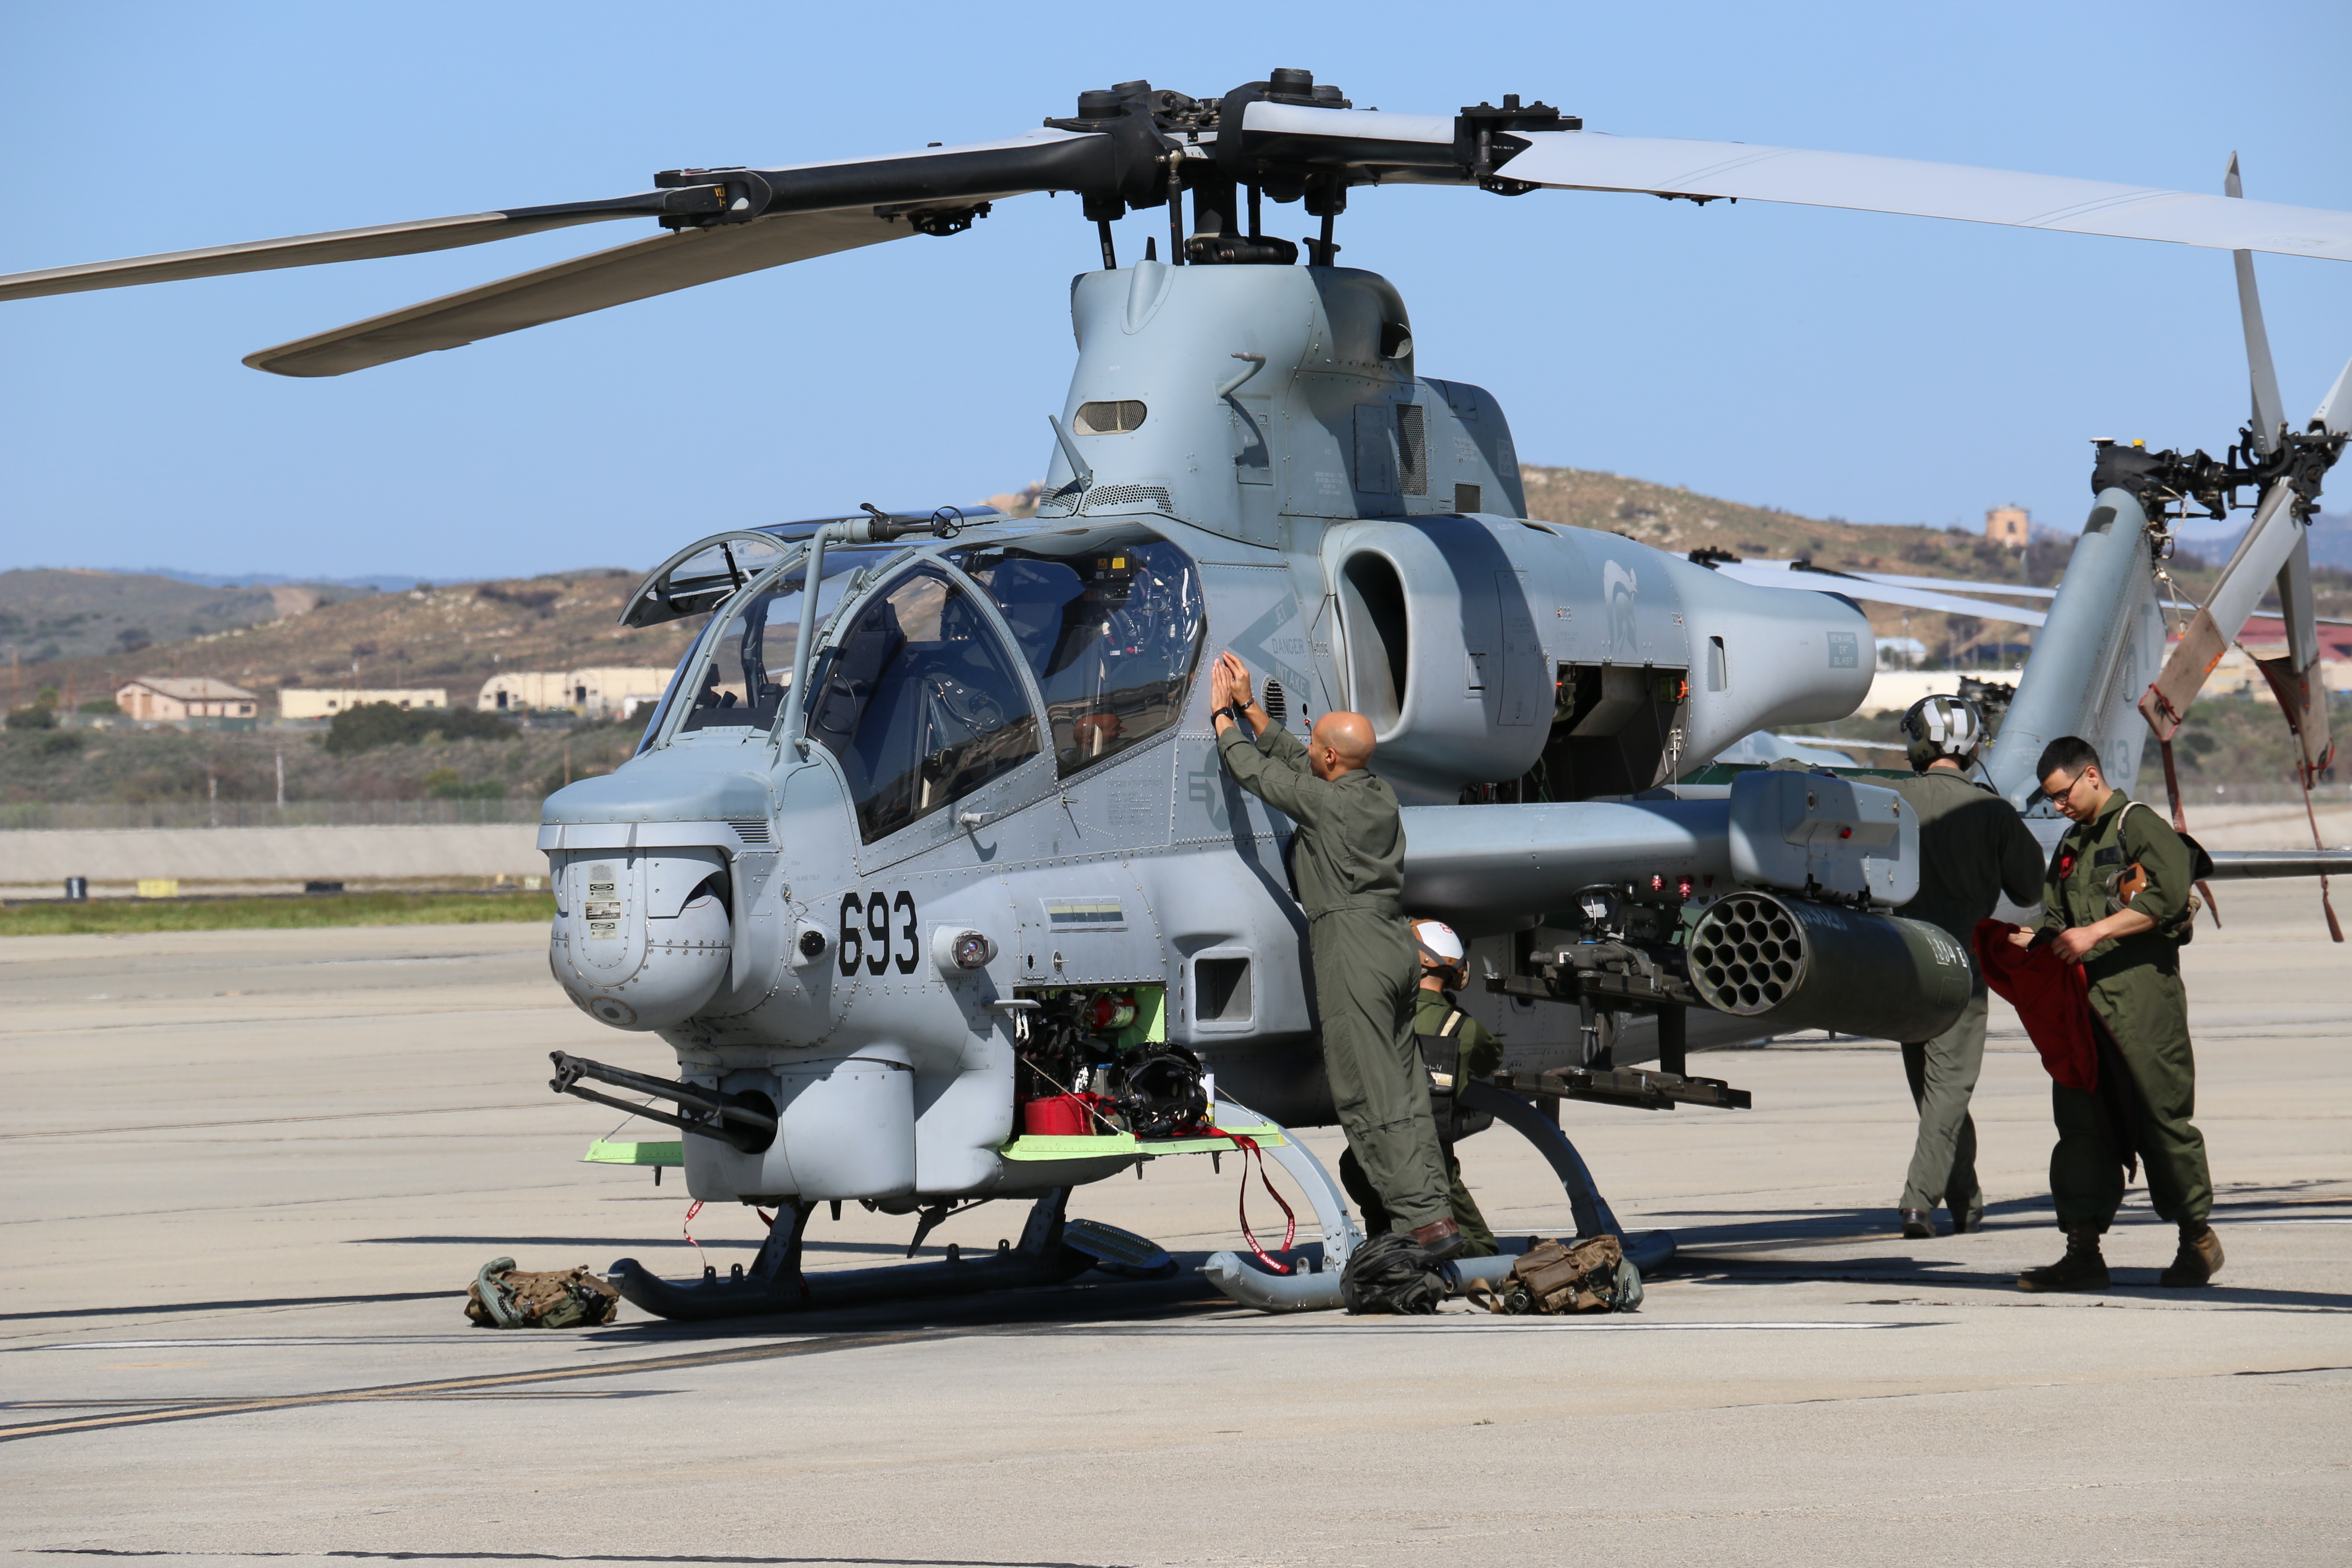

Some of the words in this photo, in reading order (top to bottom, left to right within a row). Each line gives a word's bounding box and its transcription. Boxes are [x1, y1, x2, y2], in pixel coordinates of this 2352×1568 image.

[1275, 603, 1287, 626] JET
[1272, 638, 1305, 654] DANGER
[1830, 634, 1855, 643] BEWARE
[1839, 646, 1848, 654] OF
[1834, 657, 1853, 665] BLAST
[1276, 661, 1306, 697] INTAKE
[996, 798, 1009, 812] OPEN
[932, 824, 948, 837] RESCUE
[839, 891, 919, 977] 693
[1260, 1253, 1282, 1270] REMOVE
